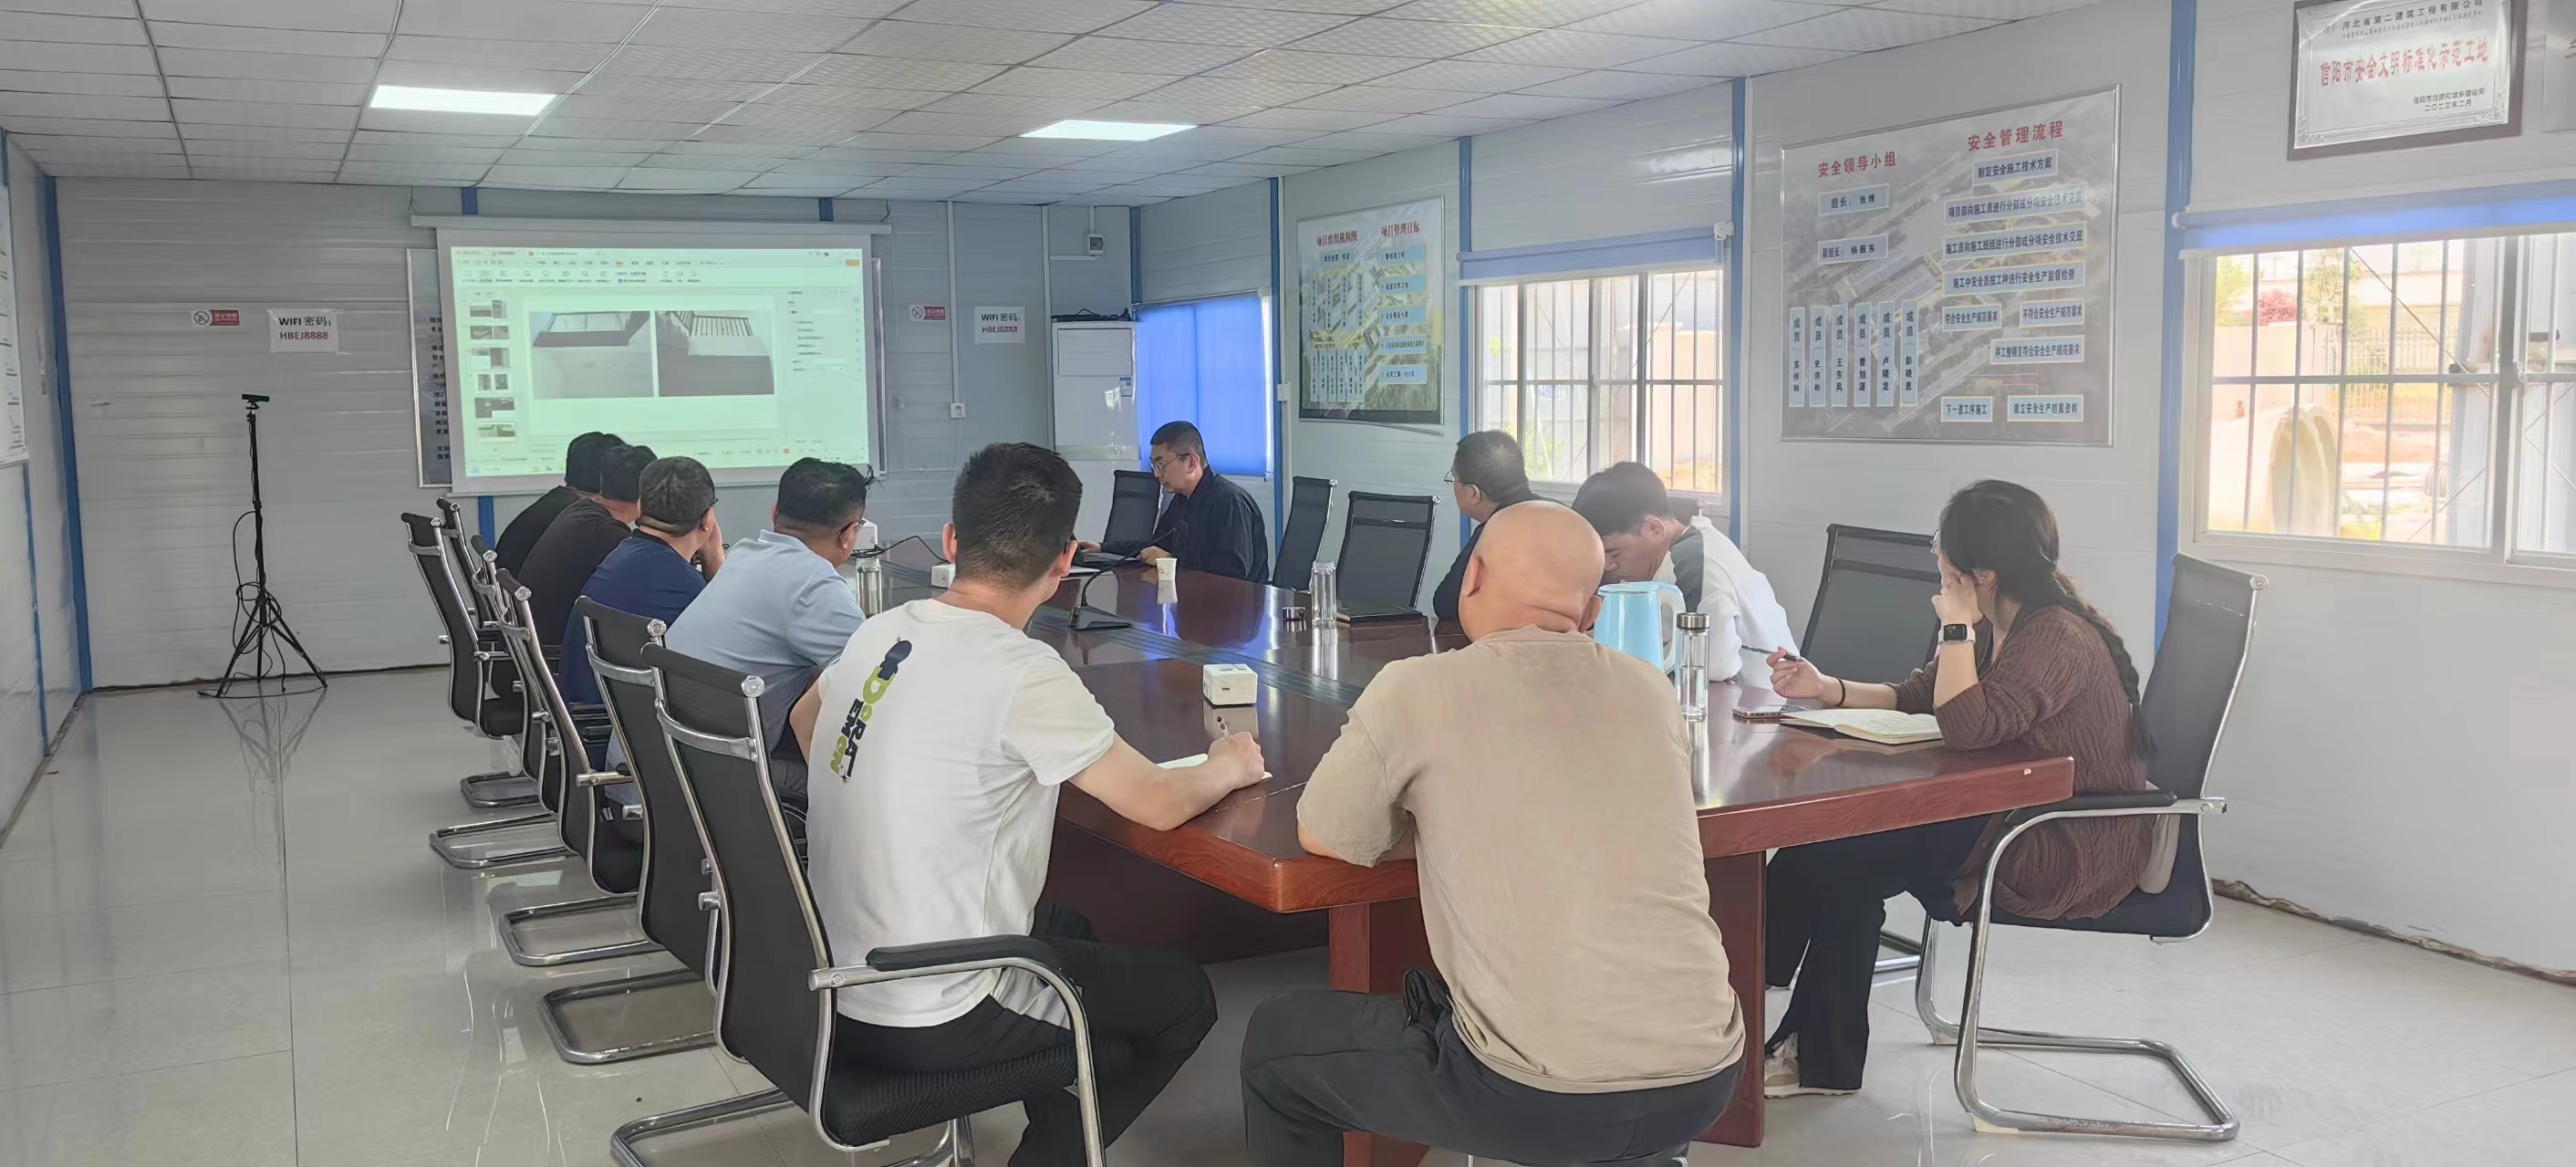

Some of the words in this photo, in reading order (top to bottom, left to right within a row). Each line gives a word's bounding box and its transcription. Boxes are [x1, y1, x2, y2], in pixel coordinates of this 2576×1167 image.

[2320, 37, 2488, 87] 信阳市安全文明标准化示范工地
[1968, 120, 2063, 151] 安全管理流程
[1818, 151, 1896, 178] 安全领导小组
[1978, 157, 2052, 178] 制定安全施工技术方案
[981, 313, 999, 321] WIFI
[1945, 310, 1999, 325] 符合安全生产规范要求
[2022, 304, 2083, 320] 不符合安全生产规范要求
[278, 317, 302, 326] WIFI
[279, 331, 328, 340] HBEJ8888
[1946, 403, 1988, 415] 下一道工序施工
